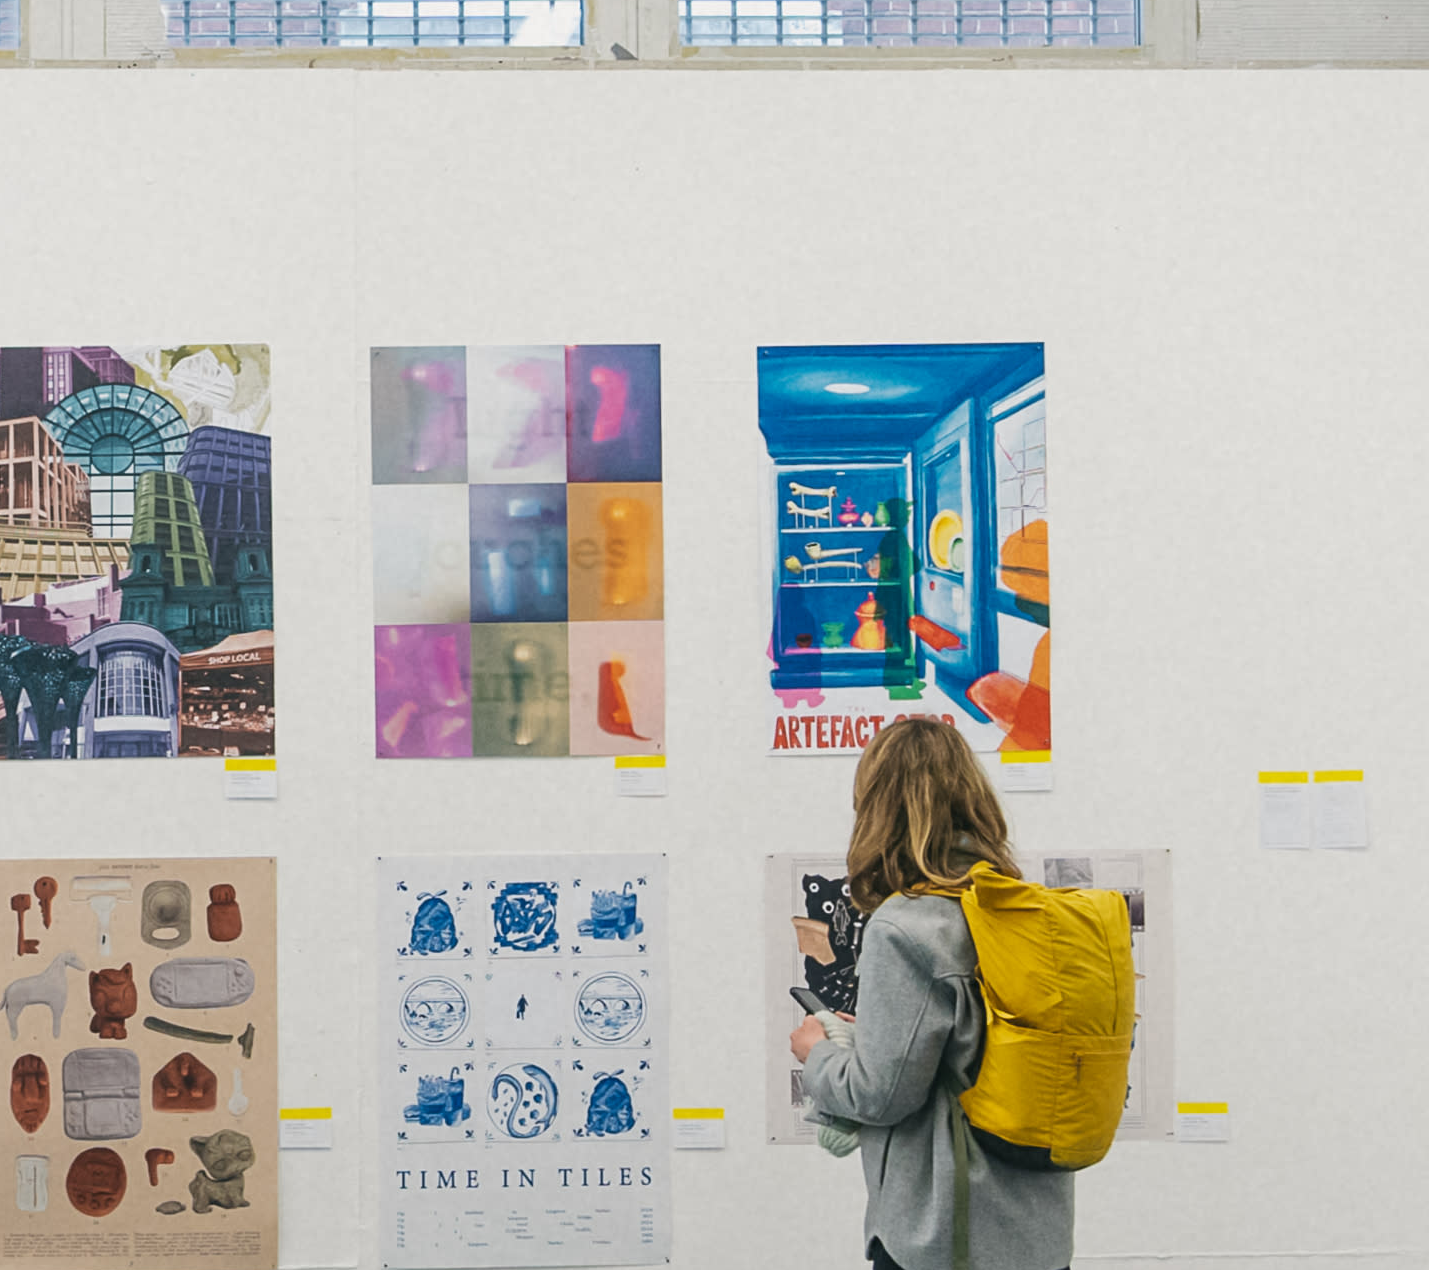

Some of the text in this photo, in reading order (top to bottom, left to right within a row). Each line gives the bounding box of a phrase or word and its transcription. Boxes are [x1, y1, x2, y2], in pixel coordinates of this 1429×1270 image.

[207, 652, 261, 665] SHOP LOCAL
[773, 715, 884, 750] ARTEFACT
[396, 1166, 653, 1190] TIME IN TILES
